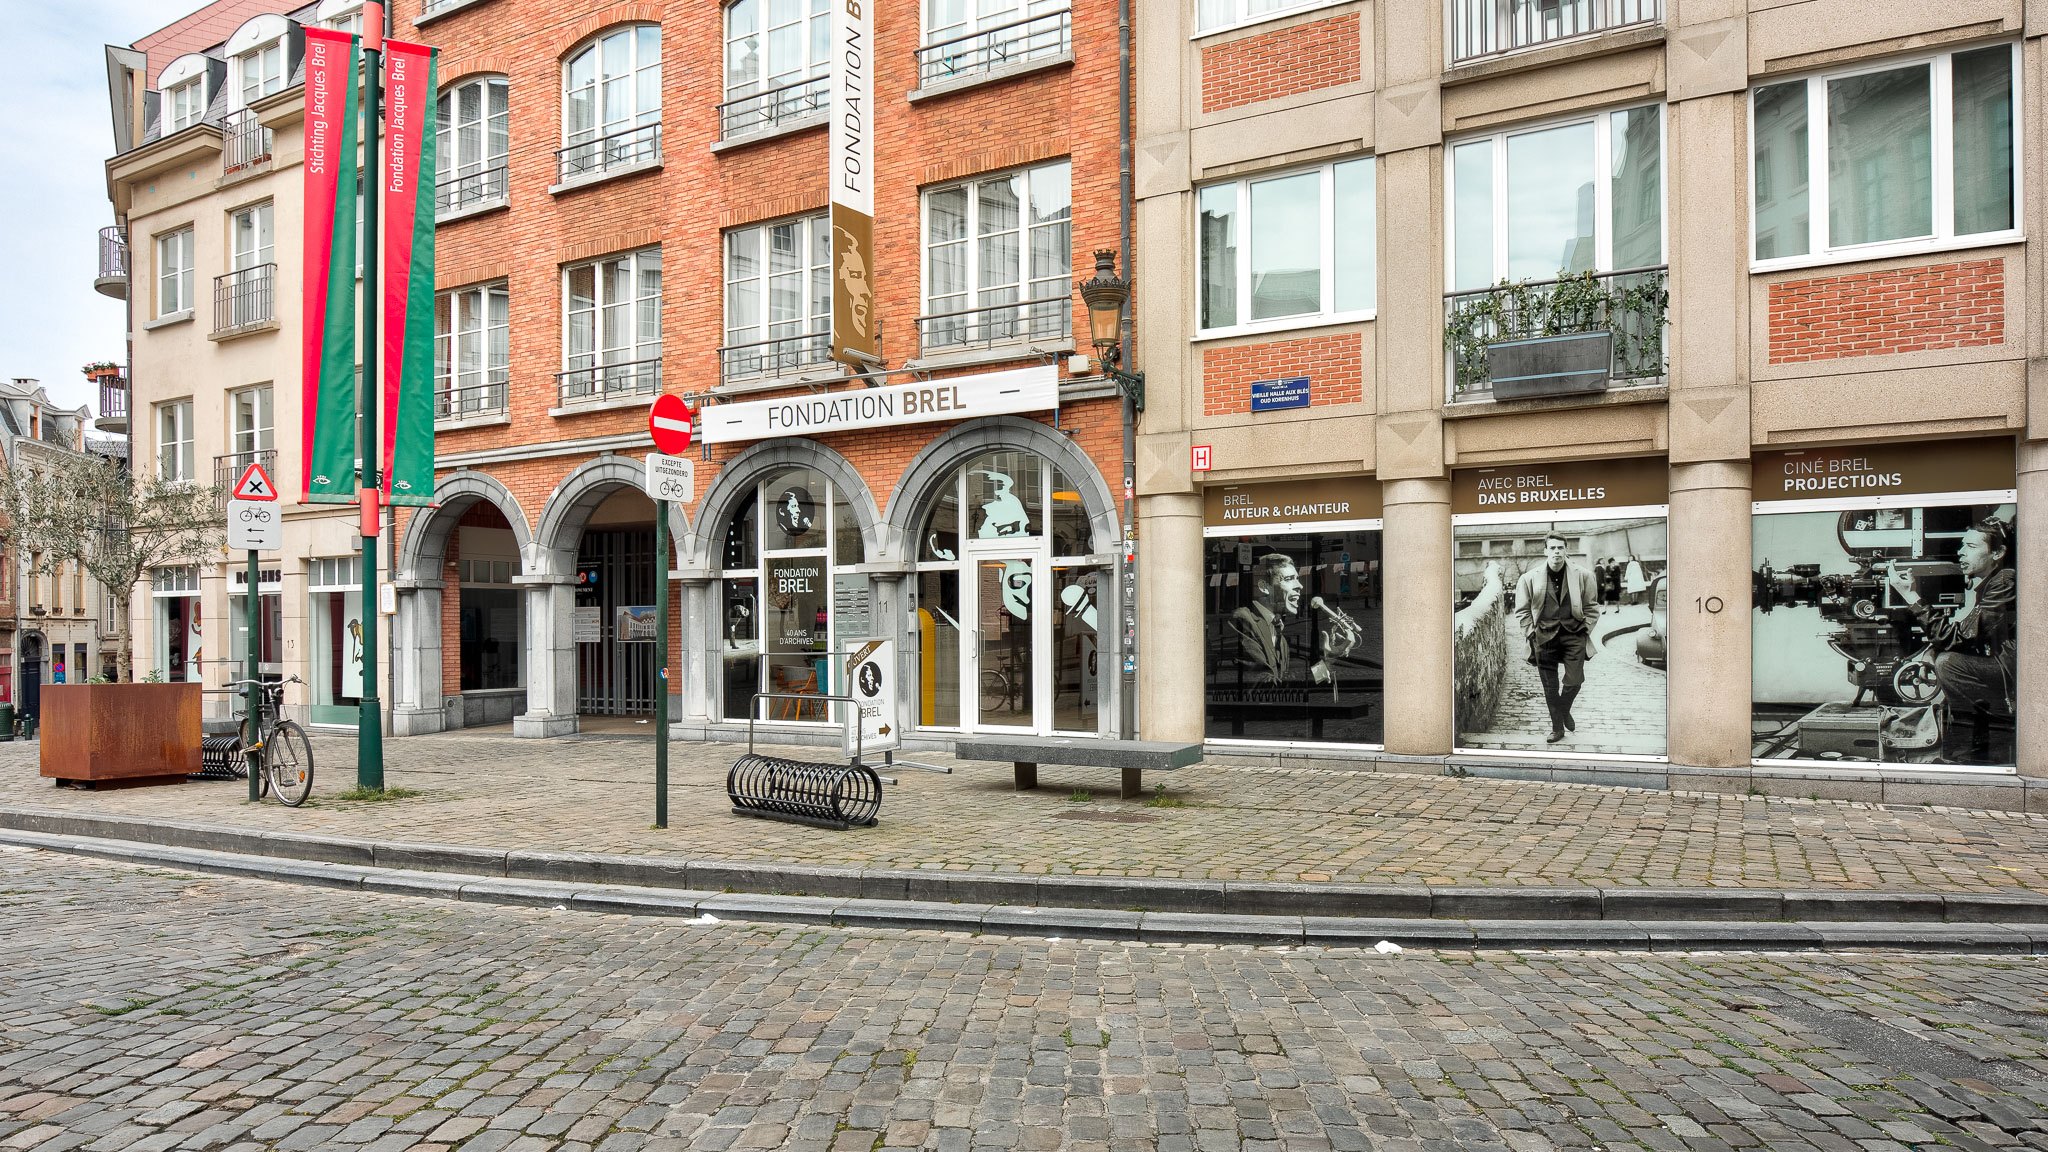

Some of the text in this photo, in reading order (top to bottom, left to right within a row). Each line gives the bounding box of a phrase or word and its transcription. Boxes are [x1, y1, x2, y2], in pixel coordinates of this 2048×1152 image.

[844, 0, 862, 192] FONDATION B
[310, 42, 328, 174] Stichting Jacques Brel
[389, 57, 408, 193] Fondation Jacques Brel
[768, 385, 967, 429] FONDATION BREL
[661, 458, 682, 468] EXCEPTE
[1196, 450, 1207, 466] H
[655, 466, 688, 477] UITGEZONDERD
[1784, 457, 1874, 475] CINÉ BREL
[1477, 475, 1553, 490] AVEC BREL
[1784, 473, 1902, 491] PROJECTIONS
[1224, 494, 1254, 506] BREL
[1478, 487, 1606, 505] DANS BRUXELLES
[1223, 502, 1350, 520] AUTEUR & CHANTEUR
[774, 567, 819, 578] FONDATION
[779, 578, 814, 593] BREL
[879, 600, 888, 614] 11
[1695, 596, 1724, 613] 10
[287, 640, 295, 649] 13
[780, 637, 814, 645] D'ARCHIVES
[860, 706, 882, 718] BREL
